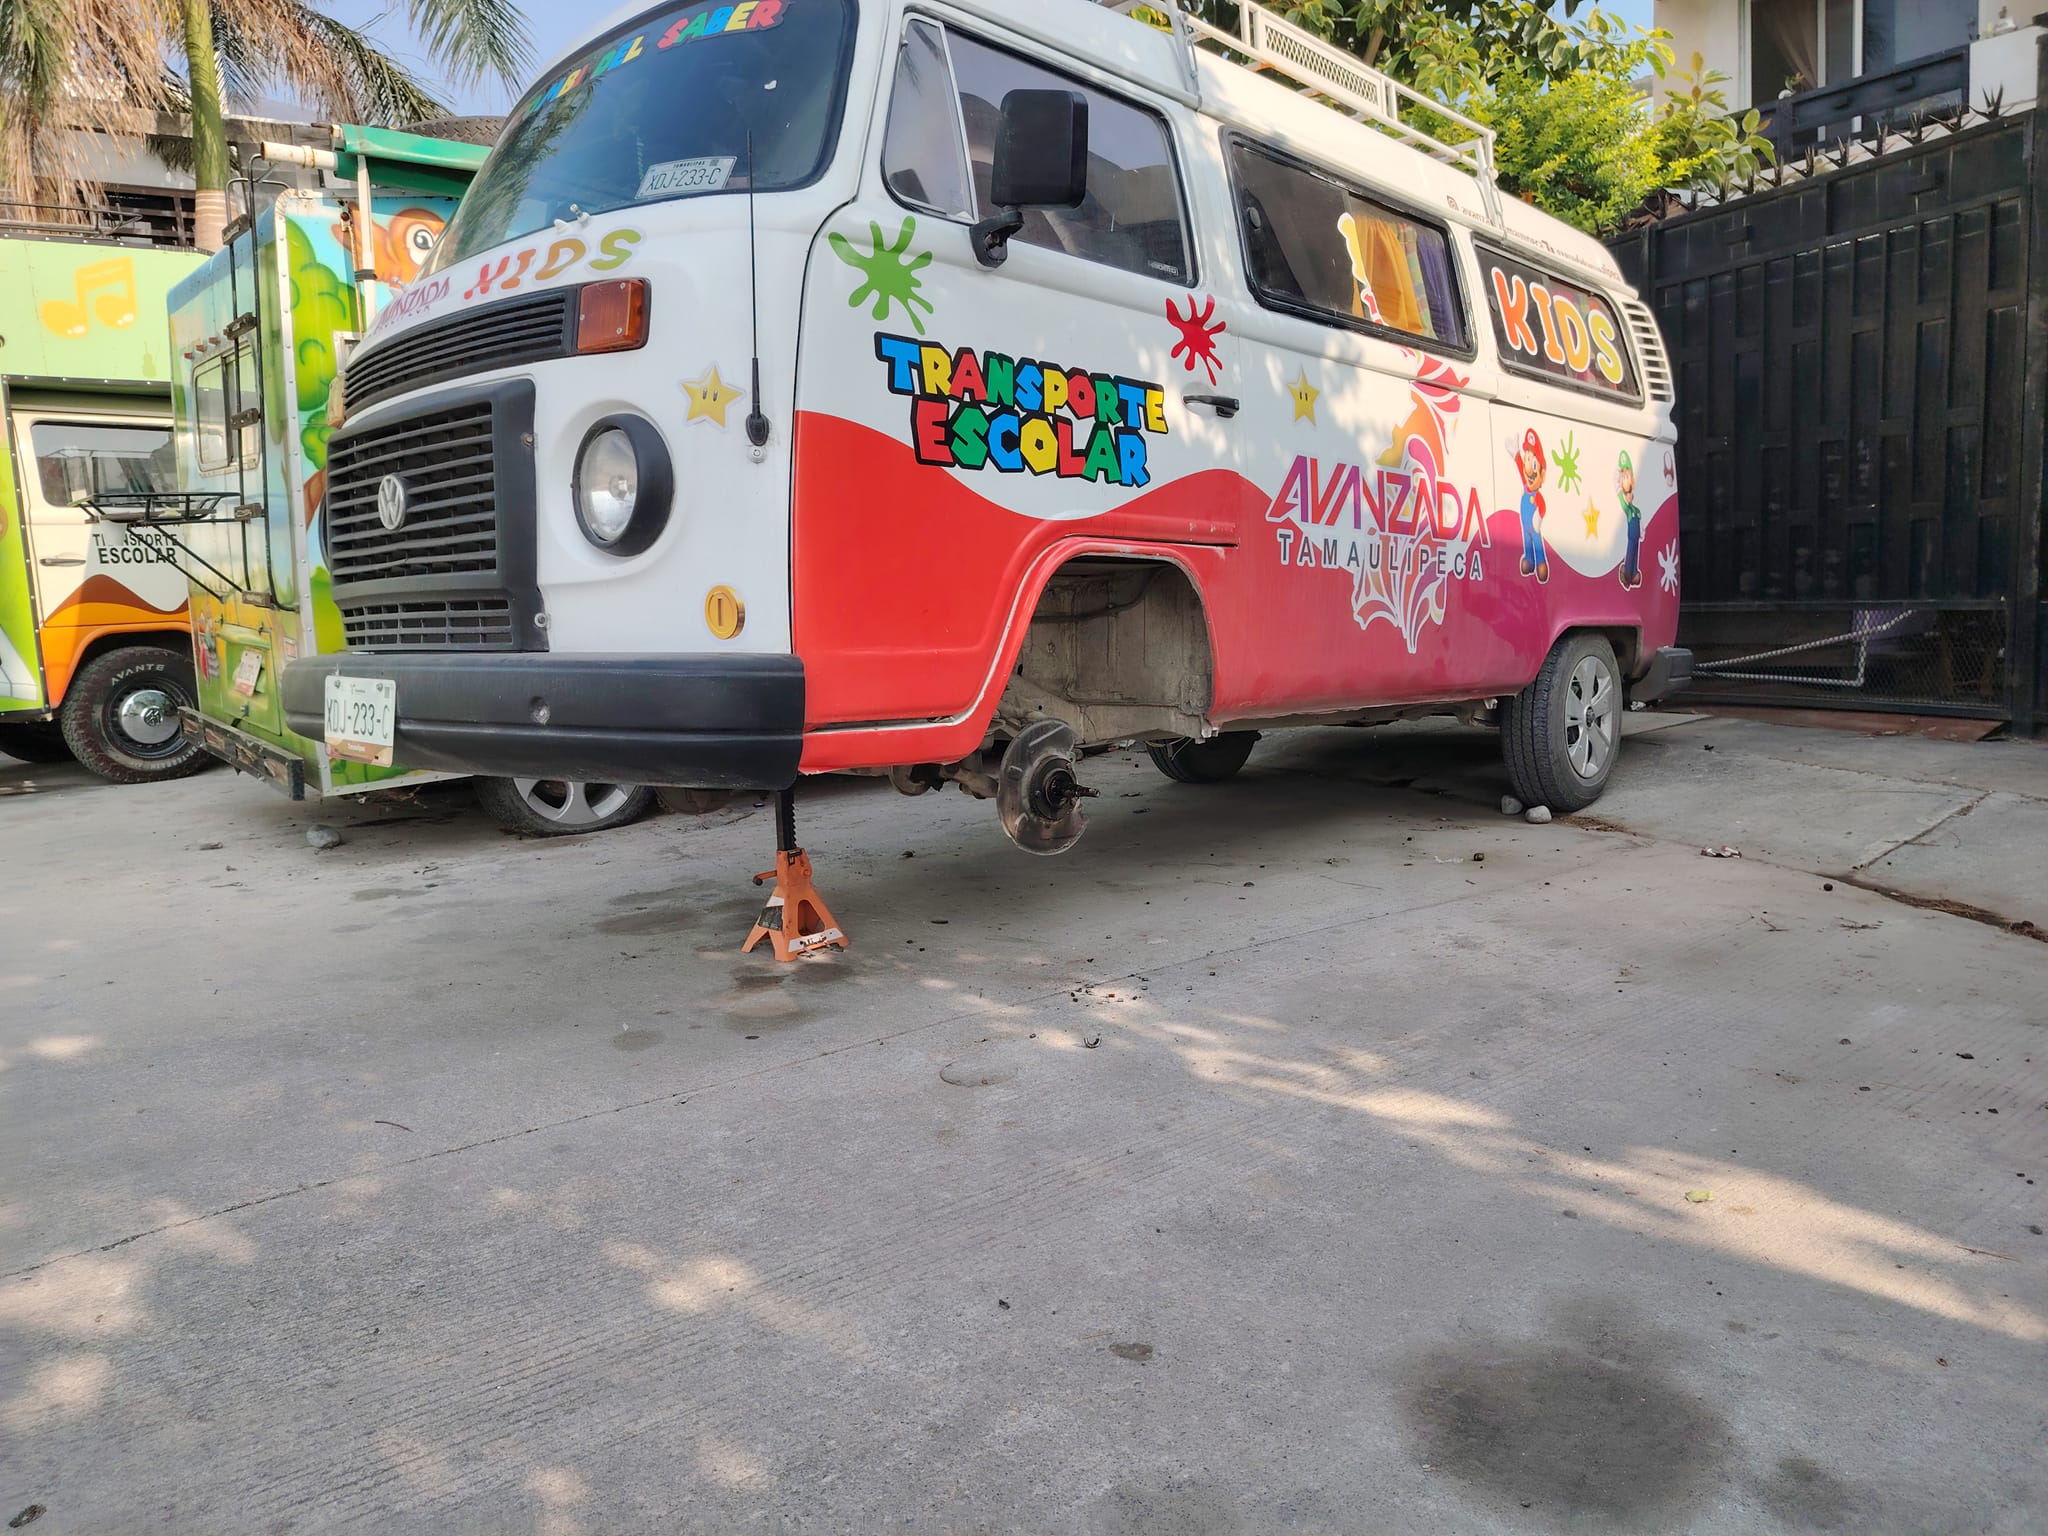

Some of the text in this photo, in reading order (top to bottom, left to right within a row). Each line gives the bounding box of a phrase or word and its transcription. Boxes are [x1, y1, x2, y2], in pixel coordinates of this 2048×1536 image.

[591, 35, 645, 79] DEL
[656, 0, 785, 50] SABER
[646, 167, 722, 192] XDJ-233-C
[463, 228, 642, 300] KIDS
[1491, 266, 1623, 384] KIDS
[875, 333, 1169, 434] TRANSPORTE
[911, 395, 1151, 487] ESCOLAR
[1267, 455, 1490, 548] AVANZADA
[98, 548, 177, 563] ESCOLAR
[1279, 532, 1484, 581] TAMAULIPECA
[110, 663, 166, 686] AVANTE
[326, 699, 390, 739] XDJ-233-C
